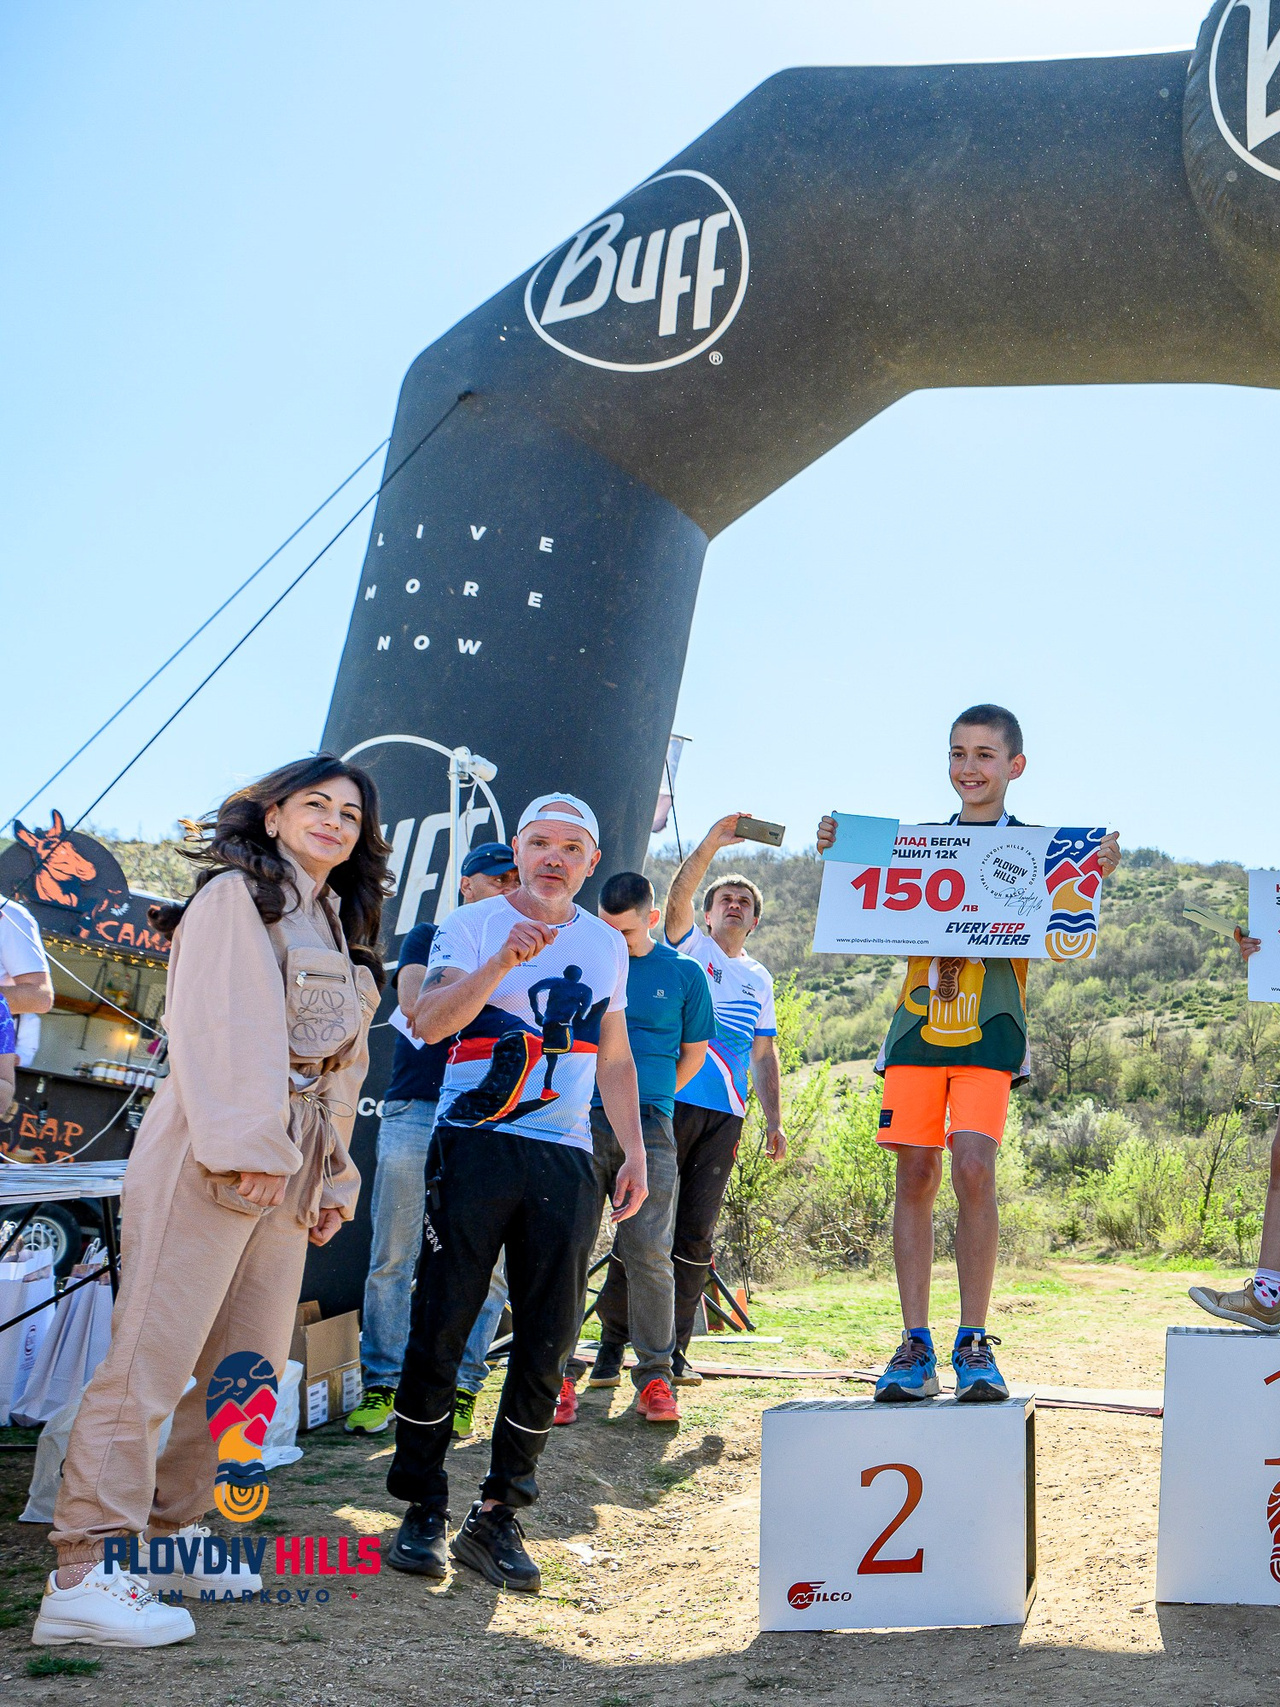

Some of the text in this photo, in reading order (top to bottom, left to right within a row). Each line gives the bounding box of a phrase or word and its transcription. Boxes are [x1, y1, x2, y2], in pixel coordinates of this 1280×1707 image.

[377, 524, 554, 553] LIVE
[377, 635, 482, 655] NOW
[893, 836, 971, 847] ЛАД БЕГАЧ
[892, 849, 931, 859] РШИЛ
[993, 857, 1028, 878] PLOVDIV
[993, 868, 1017, 885] HILLS
[850, 868, 966, 912] 150
[945, 922, 1026, 934] EVERY STEP
[967, 934, 1031, 946] MATTERS
[19, 1113, 84, 1147] БАР
[857, 1463, 924, 1575] 2
[790, 1591, 852, 1605] MILCO
